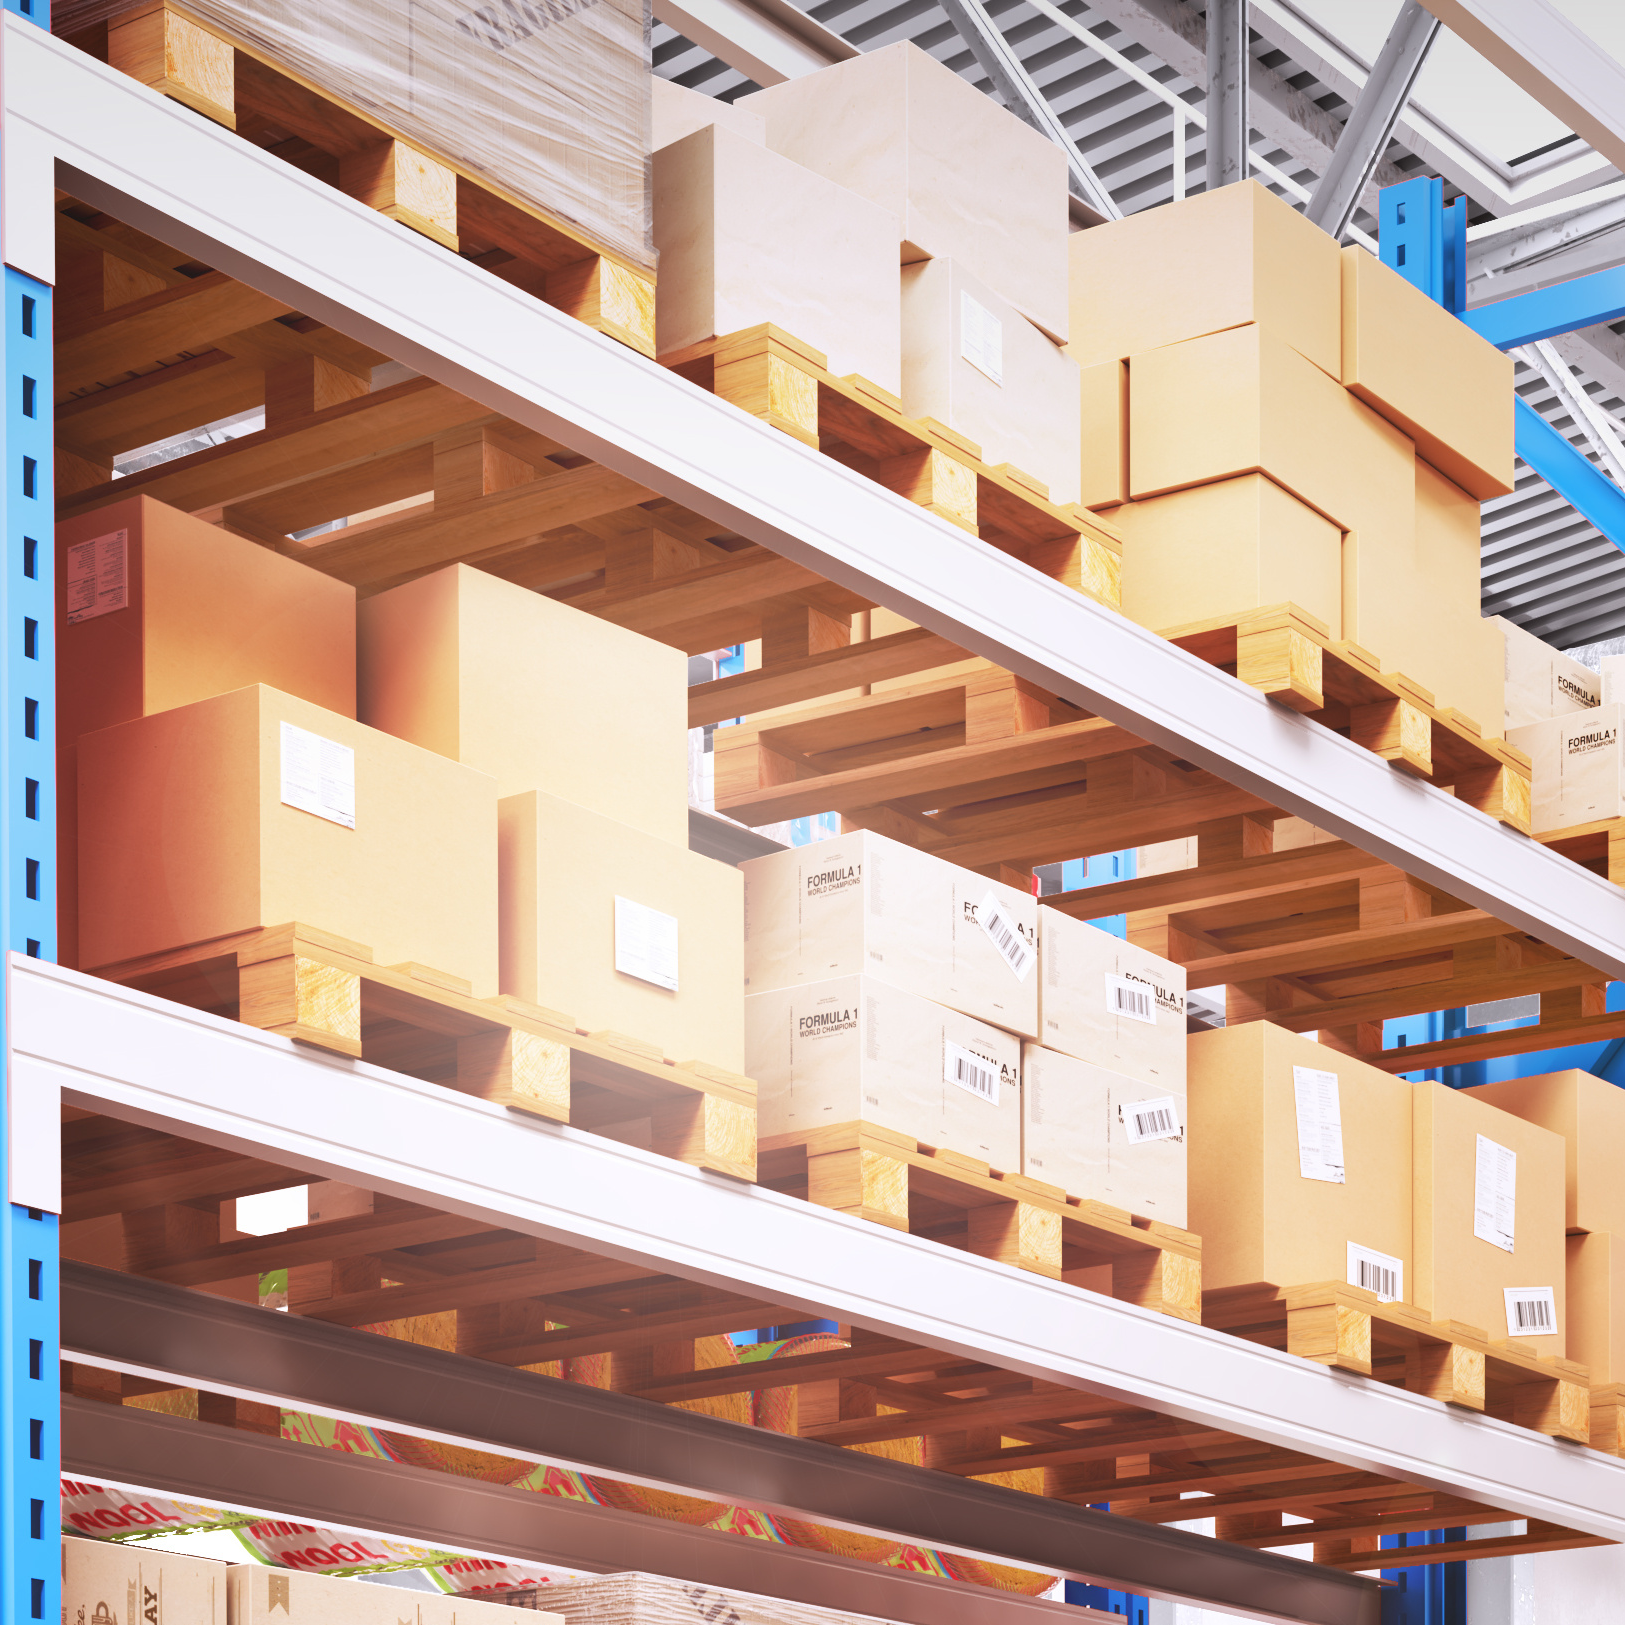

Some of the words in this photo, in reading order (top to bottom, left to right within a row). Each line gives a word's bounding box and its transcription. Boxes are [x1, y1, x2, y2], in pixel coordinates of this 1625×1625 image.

[1568, 730, 1610, 748] FORMULA
[1613, 728, 1617, 737] 1
[1568, 746, 1586, 755] WORLD
[1587, 739, 1616, 751] CHAMPIONS
[807, 866, 854, 888] FORMULA
[857, 864, 861, 876] 1
[808, 884, 827, 896] WORLD
[829, 877, 860, 892] CHAMPIONS
[799, 1010, 850, 1030] FORMULA
[853, 1008, 858, 1020] 1
[799, 1026, 821, 1038] WORLD
[822, 1020, 857, 1035] CHAMPIONS
[67, 1499, 180, 1533] WOOL
[276, 1541, 390, 1572] WOOL
